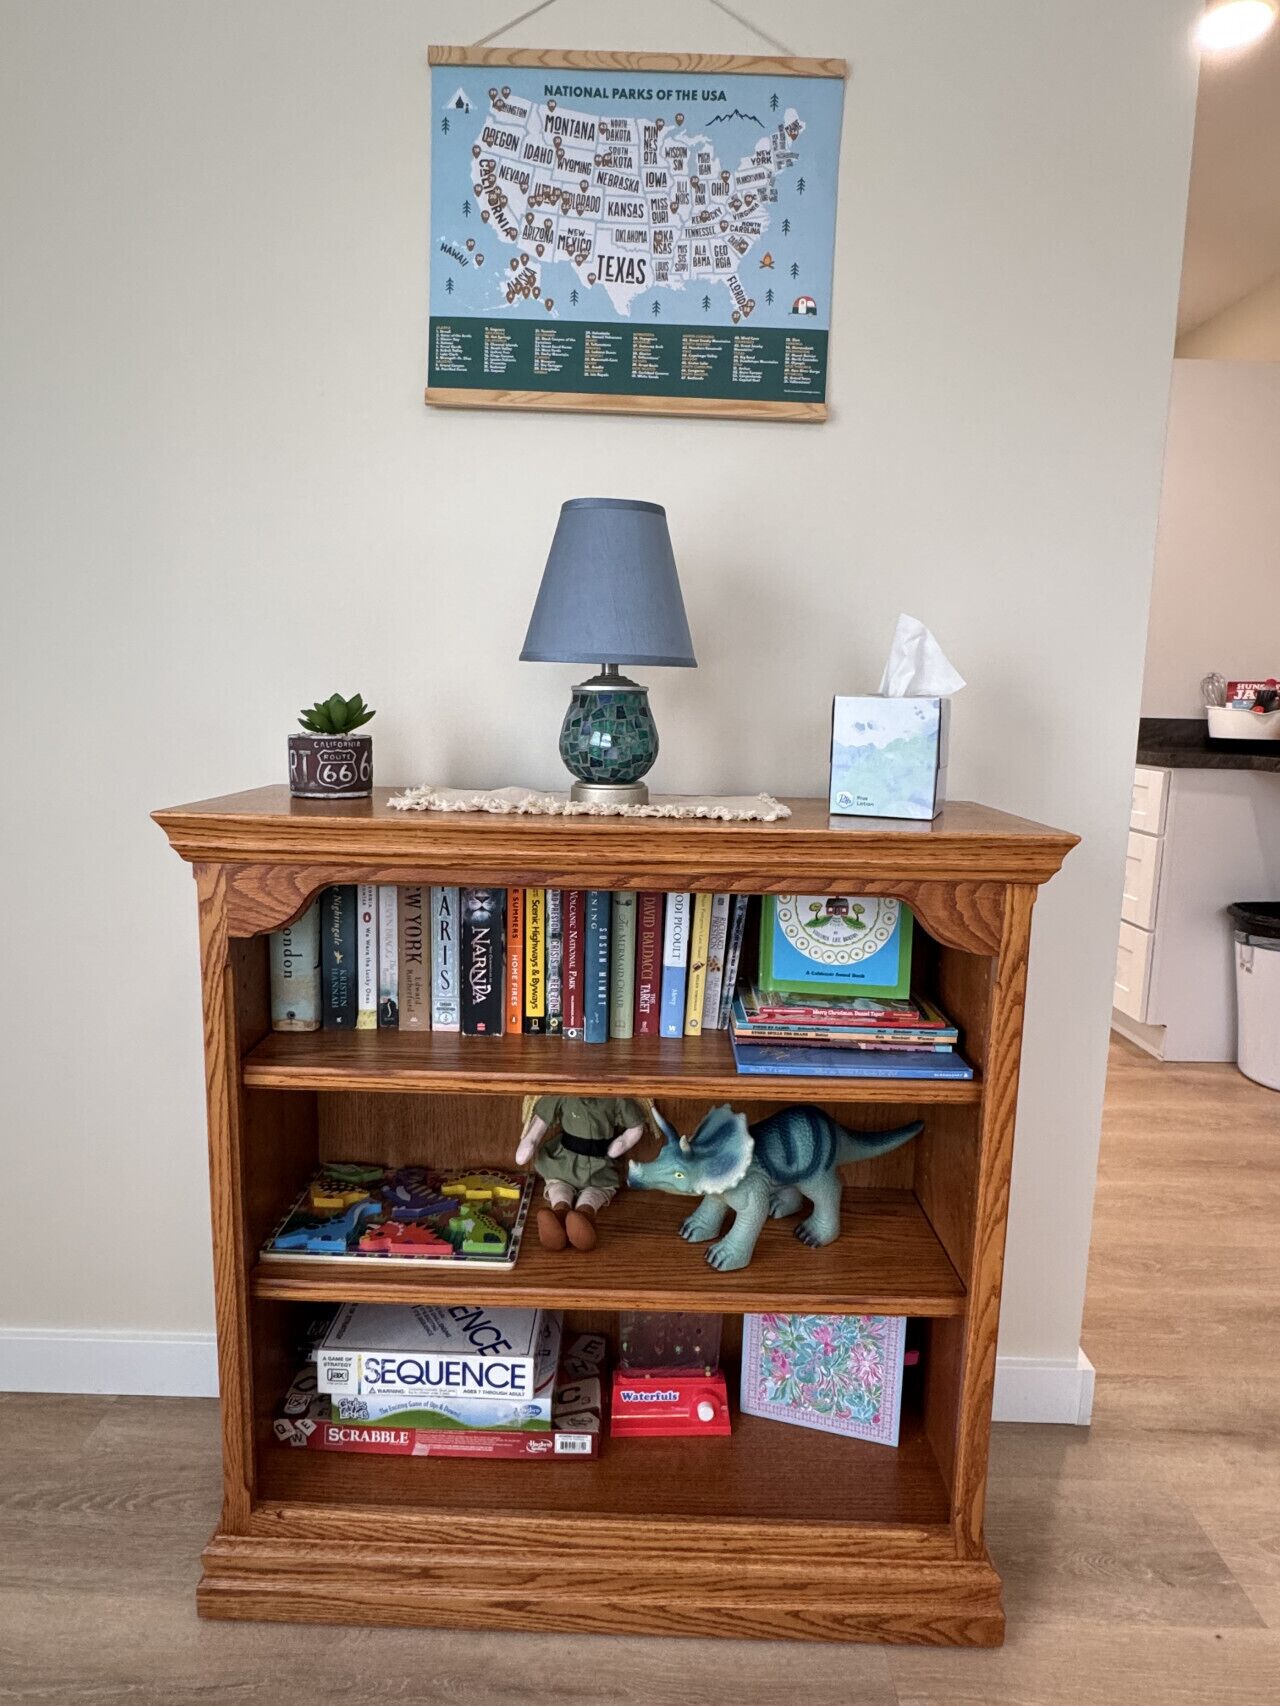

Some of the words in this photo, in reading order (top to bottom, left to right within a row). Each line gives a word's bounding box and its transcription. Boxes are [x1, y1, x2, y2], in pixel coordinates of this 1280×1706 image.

[544, 85, 609, 99] NATIONAL
[612, 88, 652, 100] PARKS
[657, 90, 675, 100] OF
[676, 90, 700, 101] THE
[702, 90, 726, 101] USA
[545, 115, 595, 141] MONTANA
[611, 120, 627, 128] NORTH
[644, 126, 657, 138] MIN
[482, 127, 519, 152] OREGON
[606, 128, 631, 142] DAKOTA
[524, 143, 553, 165] IDAHO
[608, 147, 628, 155] SOUTH
[644, 139, 657, 151] NES
[557, 158, 591, 176] WYOMING
[644, 151, 657, 165] OTA
[674, 160, 683, 171] SIN
[499, 165, 529, 184] NEVADA
[596, 171, 639, 193] NEBRASKA
[646, 172, 667, 188] IOWA
[712, 183, 730, 196] OHIO
[608, 201, 644, 219] KANSAS
[651, 199, 668, 210] MISS
[733, 202, 760, 220] VIRGINIA
[652, 212, 668, 224] OURI
[522, 225, 553, 244] ARIZONA
[568, 228, 585, 236] NEW
[615, 229, 647, 243] OKLAHOMA
[685, 226, 716, 238] TENNESSEE
[729, 225, 760, 235] CAROLINA
[558, 235, 591, 252] MEXICO
[695, 245, 706, 255] ALA
[714, 245, 728, 256] GEO
[440, 243, 469, 267] HAWAII
[693, 257, 711, 267] BAMA
[598, 255, 646, 284] TEXAS
[727, 276, 748, 306] FLORID
[290, 750, 311, 782] RT
[323, 764, 353, 782] 66
[532, 900, 540, 924] Scenic
[569, 891, 577, 928] VOLCANIC
[643, 897, 656, 927] DAVID
[674, 895, 684, 914] ODI
[332, 895, 343, 945] Nightingale
[551, 904, 559, 933] PRESTON
[404, 915, 422, 964] YORK
[439, 888, 452, 991] ARIS
[672, 917, 683, 960] PICOULT
[717, 917, 726, 950] RICHARD
[283, 928, 303, 979] ondon
[531, 926, 540, 967] Highways
[551, 940, 559, 964] CRISIS
[569, 931, 577, 968] NATIONAL
[598, 928, 607, 963] SUSAN
[616, 933, 626, 978] MERMAID
[641, 932, 654, 979] BALDACCI
[469, 926, 491, 1005] NARNIA
[532, 969, 539, 977] &
[568, 971, 577, 990] PARK
[598, 972, 606, 1006] MINOT
[530, 978, 539, 1009] Byways
[616, 980, 625, 1008] CHAIR
[640, 984, 651, 1014] TARGET
[668, 988, 678, 1006] Mercy
[551, 995, 559, 1013] ZONE
[812, 1009, 828, 1017] Merry
[448, 1306, 512, 1356] ENCE
[364, 1358, 526, 1389] SEQUENCE
[408, 1401, 424, 1409] Game
[621, 1391, 679, 1402] Waterfuls
[328, 1428, 410, 1444] SCRABBLE
